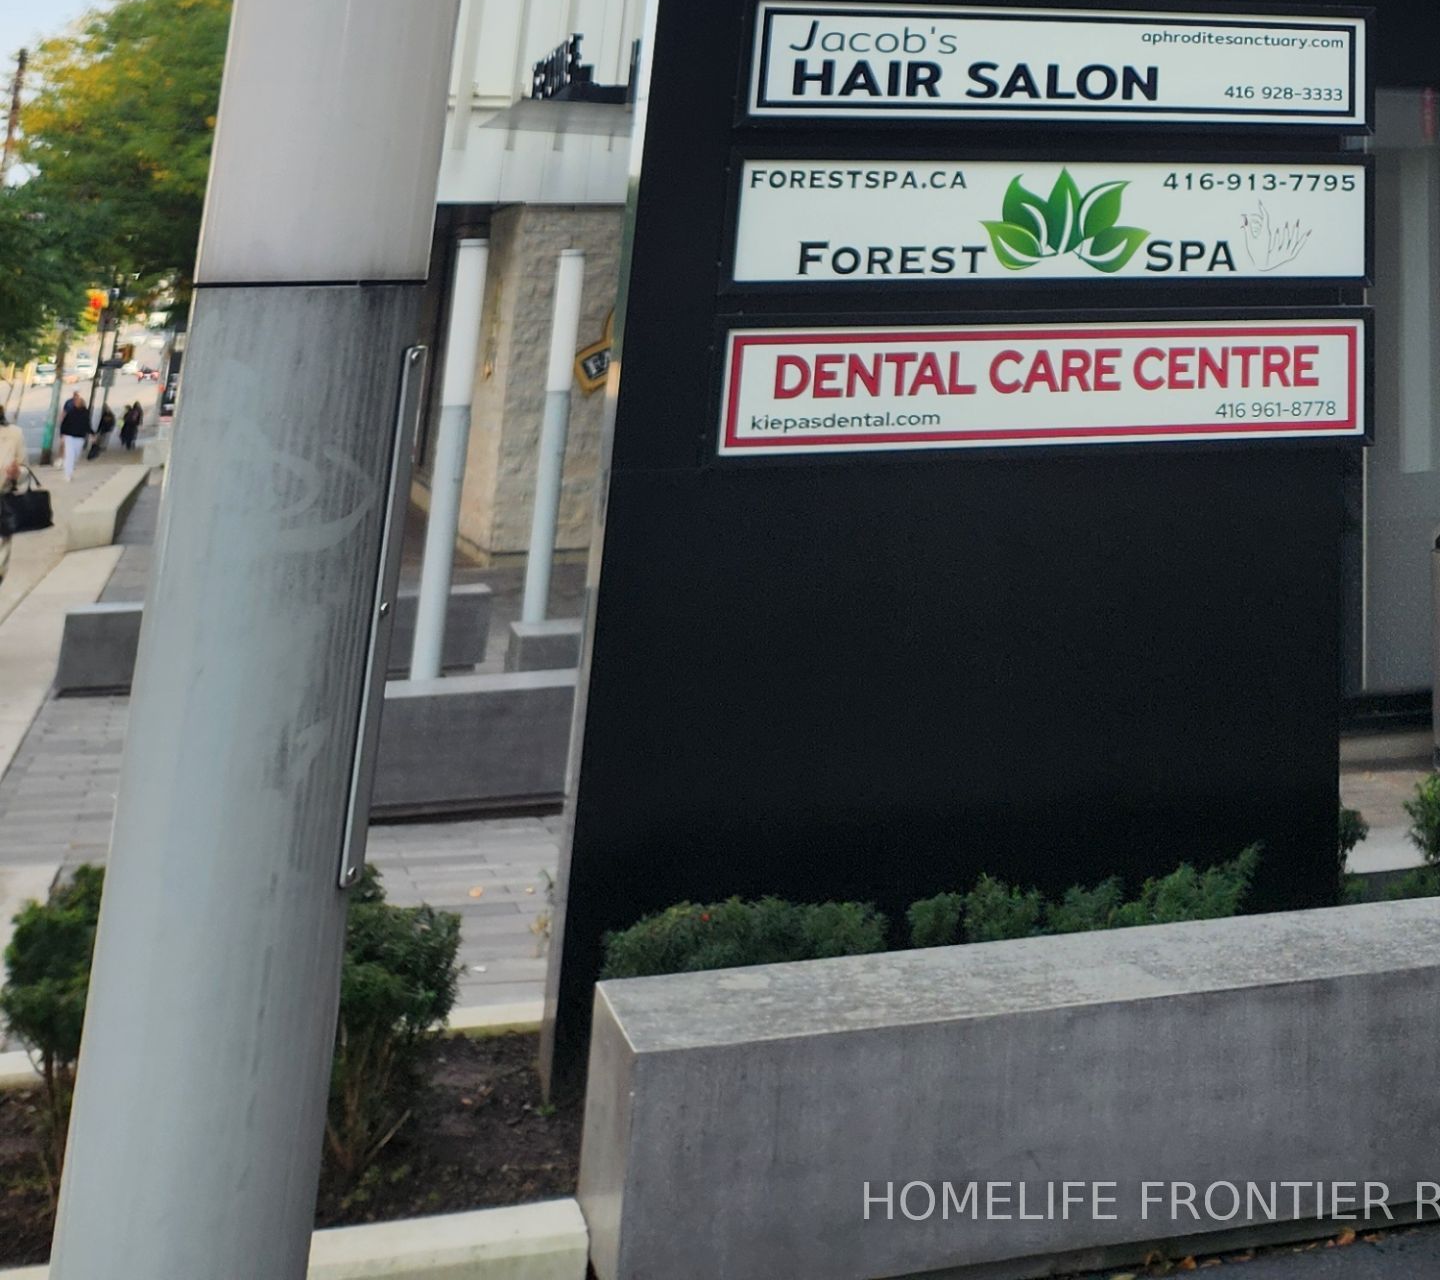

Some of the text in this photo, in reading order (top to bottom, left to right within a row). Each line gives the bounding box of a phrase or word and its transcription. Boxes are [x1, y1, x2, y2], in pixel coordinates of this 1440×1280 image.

[789, 20, 957, 55] Jacob's
[1140, 30, 1345, 51] aphroditesanctuary.com
[791, 58, 1159, 101] HAIR SALON
[1224, 84, 1344, 102] 416 928-3333
[749, 169, 968, 190] FORESTSPA.CA
[1162, 172, 1356, 193] 416-913-7795
[1145, 240, 1238, 272] SPA
[773, 345, 1321, 400] DENTAL CARE CENTRE
[1215, 399, 1337, 418] 416 961-8778
[750, 409, 941, 435] kiepasdental.com
